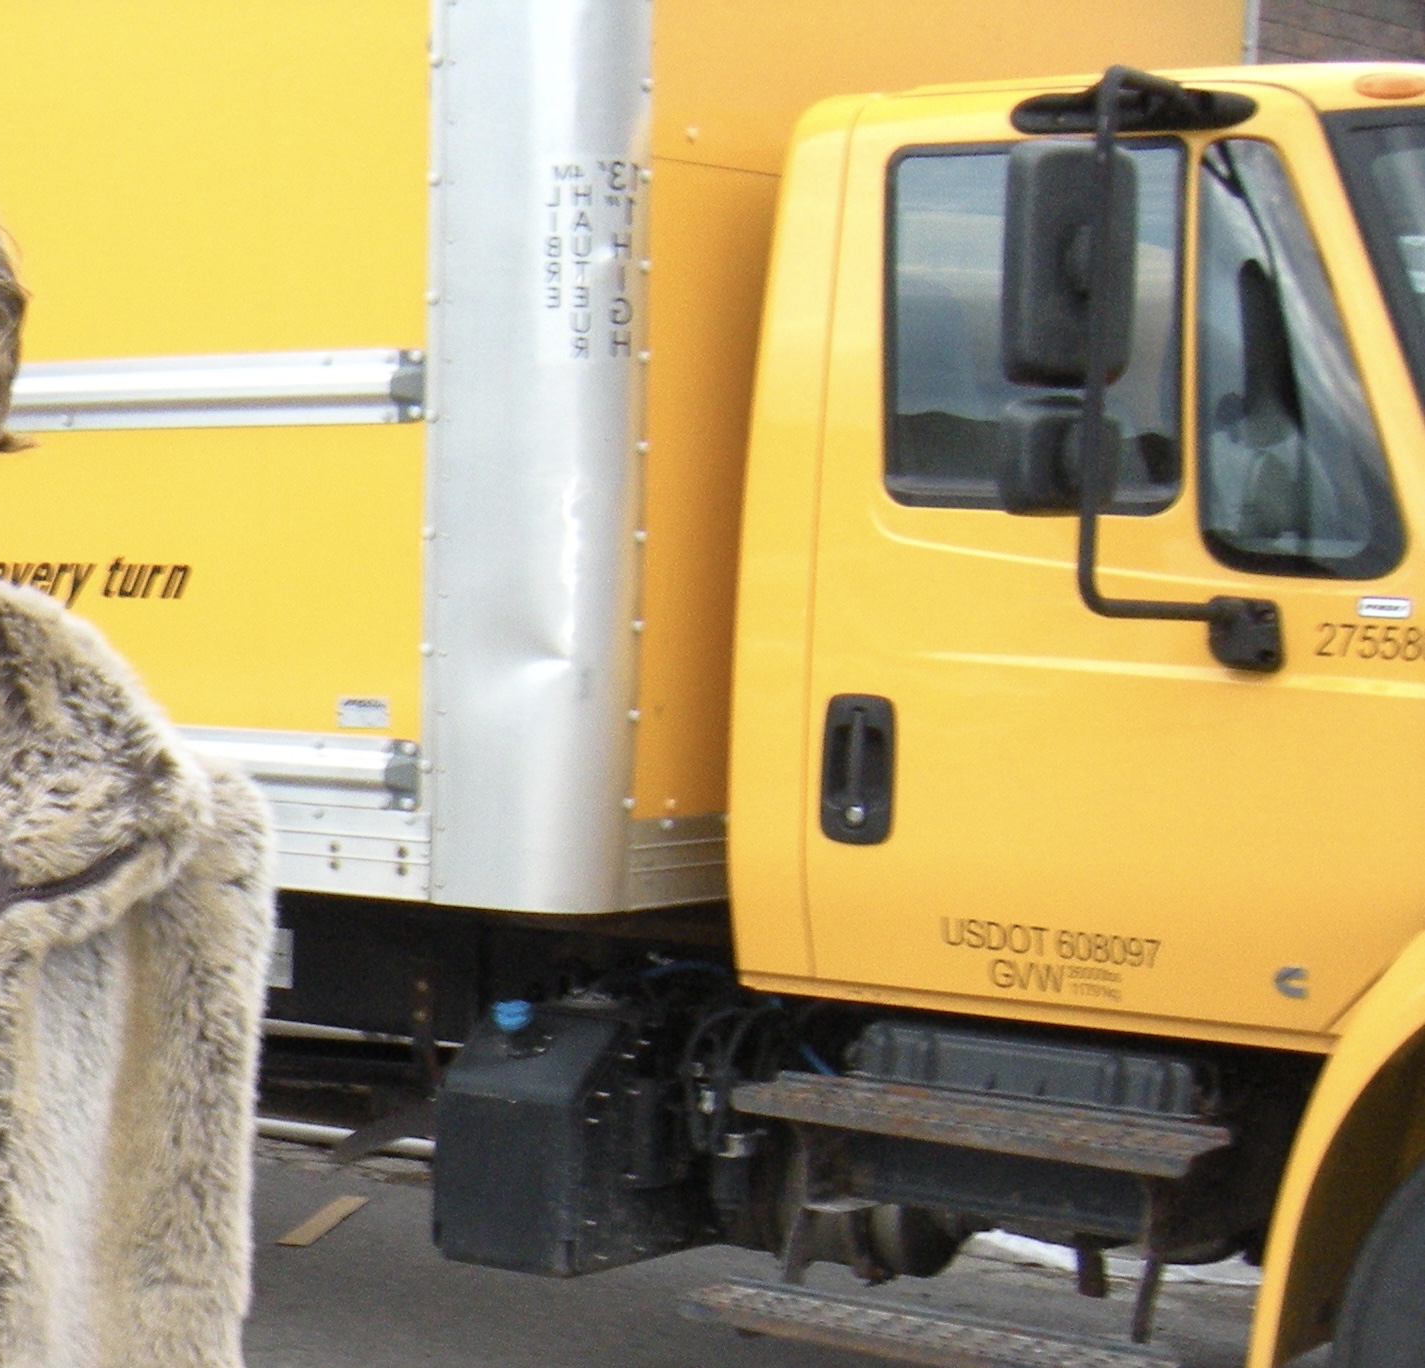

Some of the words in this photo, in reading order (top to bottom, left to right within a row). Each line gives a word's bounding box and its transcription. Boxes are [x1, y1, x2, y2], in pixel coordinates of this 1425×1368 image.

[101, 556, 193, 600] turn
[1315, 622, 1425, 661] 27558
[940, 916, 1050, 956] USDOT
[1056, 930, 1162, 968] 608097
[989, 958, 1065, 994] GVW
